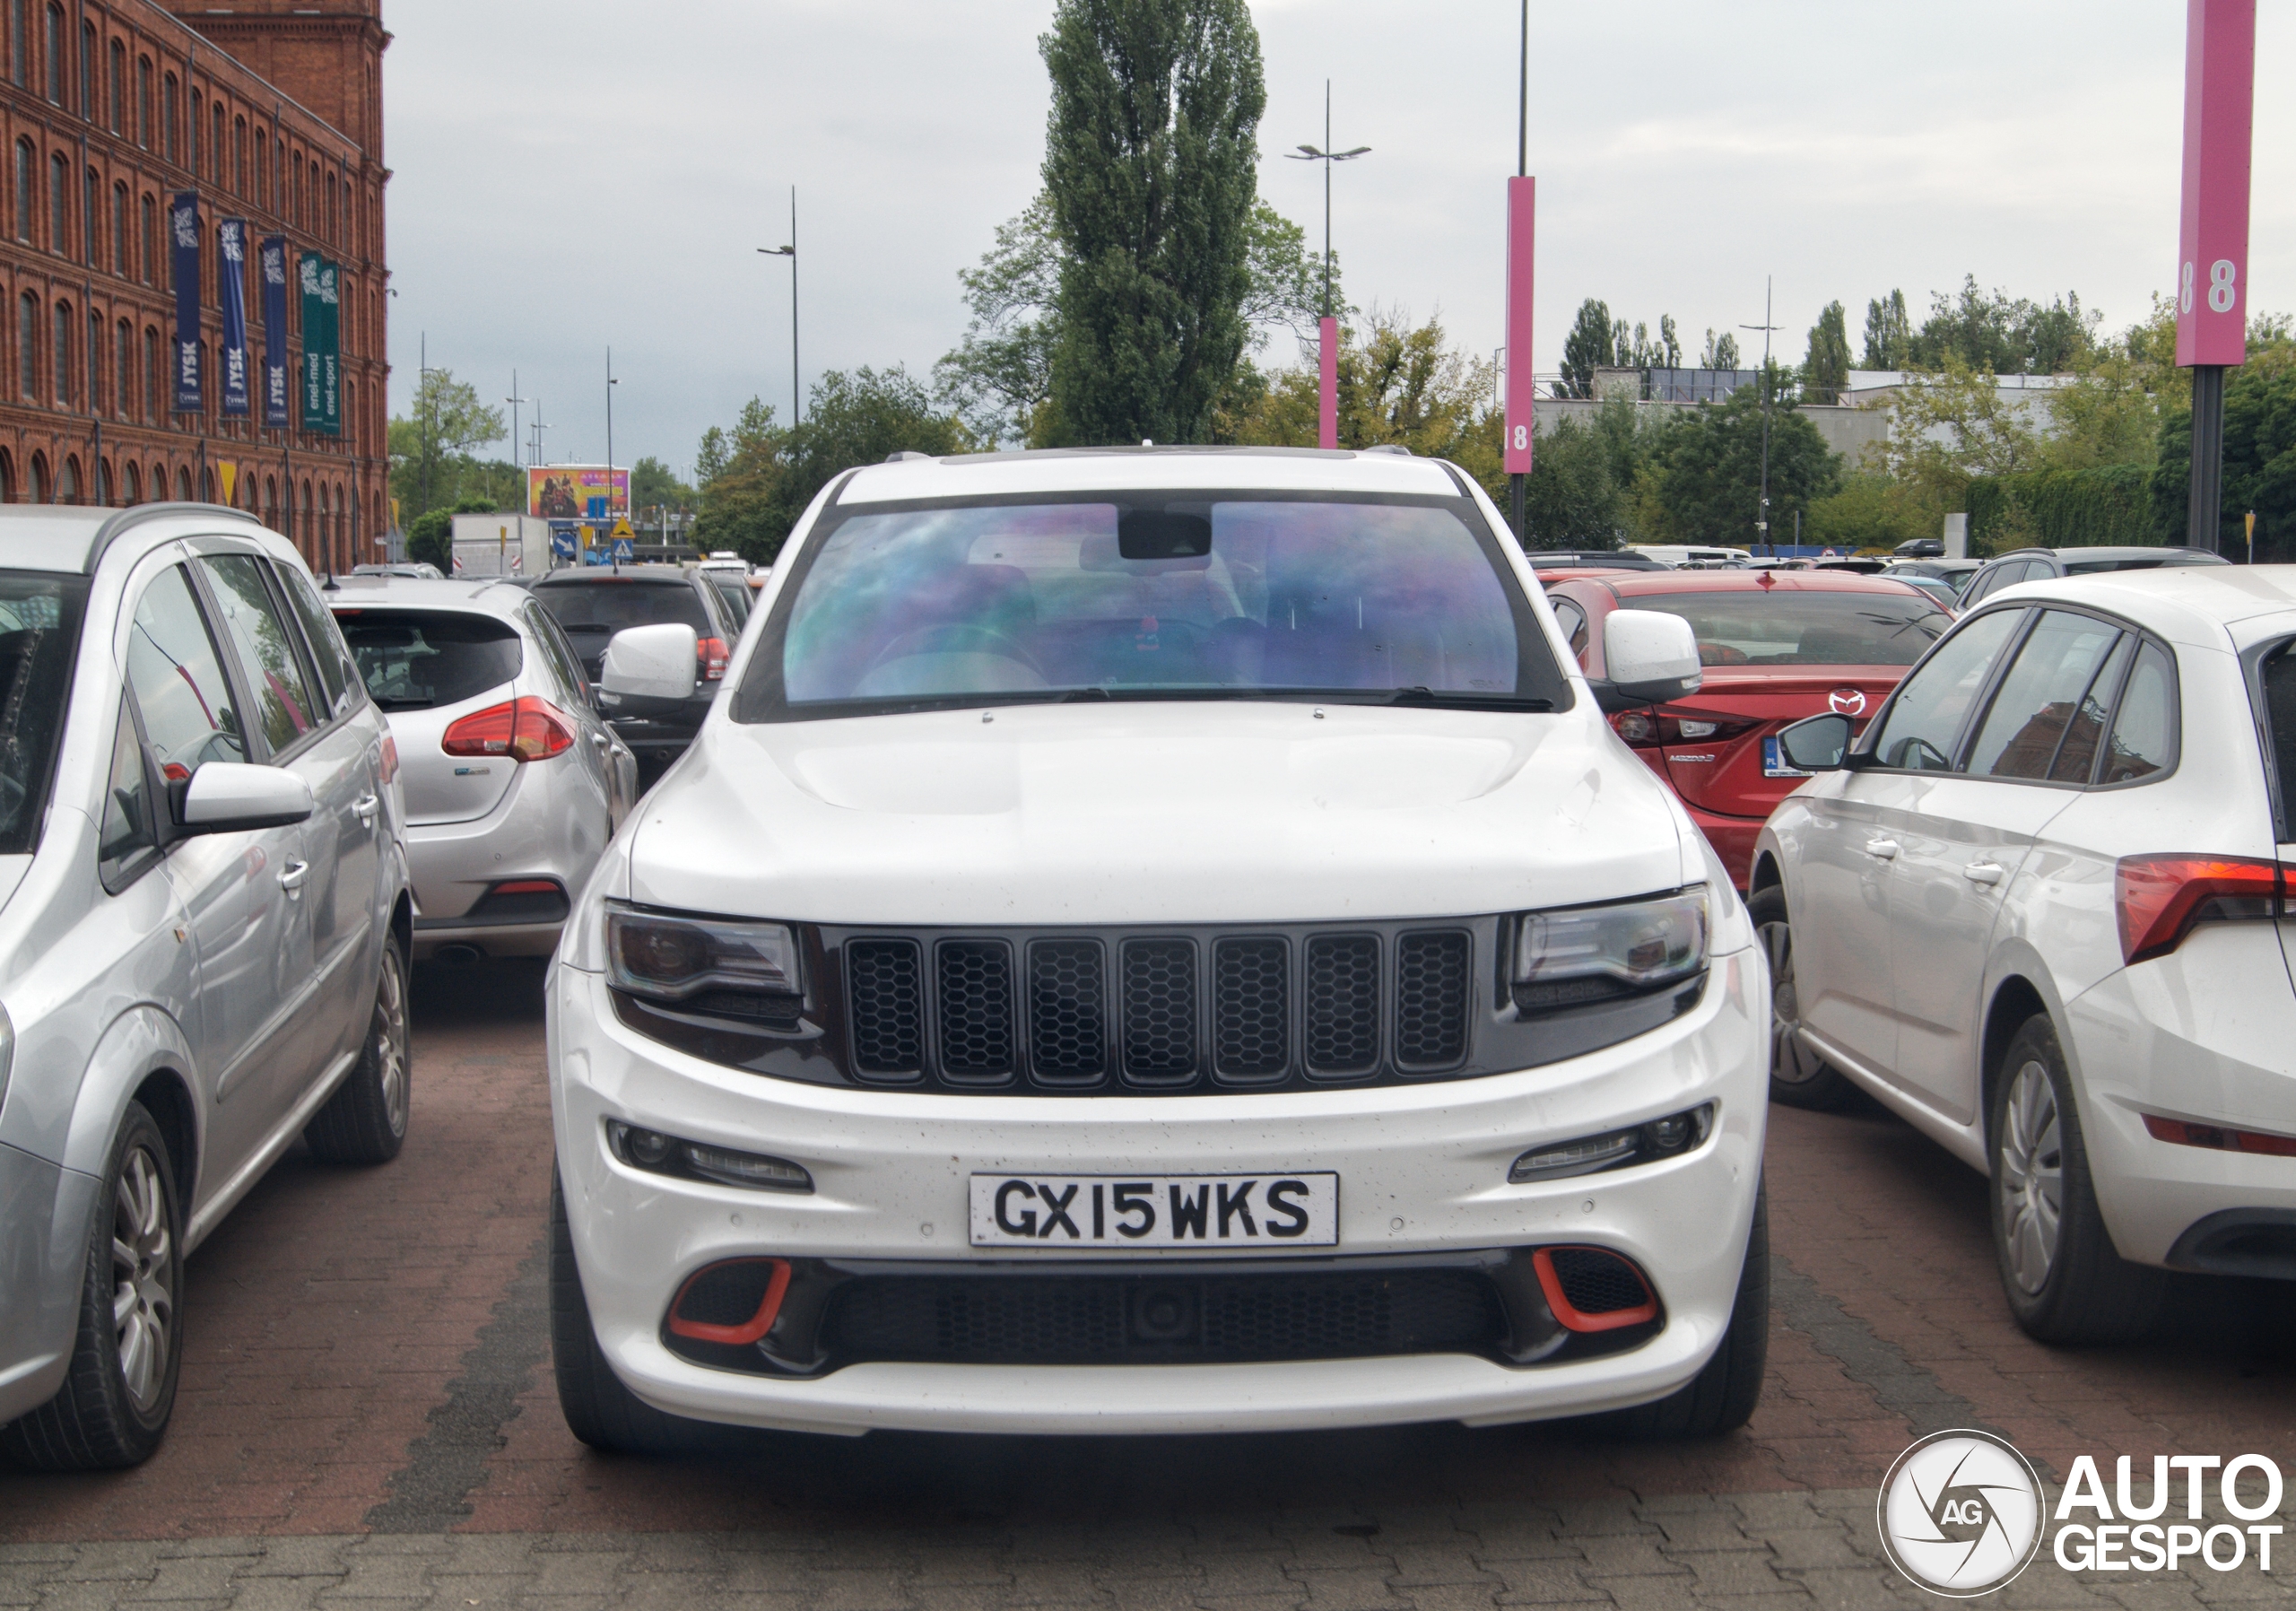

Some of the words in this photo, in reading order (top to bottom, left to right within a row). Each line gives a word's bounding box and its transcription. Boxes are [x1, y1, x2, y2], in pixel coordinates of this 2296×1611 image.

[2181, 261, 2193, 314] 8
[2208, 259, 2236, 313] 8
[182, 341, 197, 388] JYSK
[229, 347, 243, 390] JYSK
[270, 366, 283, 406] JYSK
[308, 353, 318, 410] enel-med
[325, 354, 336, 415] enel-sport
[1514, 425, 1527, 450] 8
[1767, 758, 1777, 766] PL
